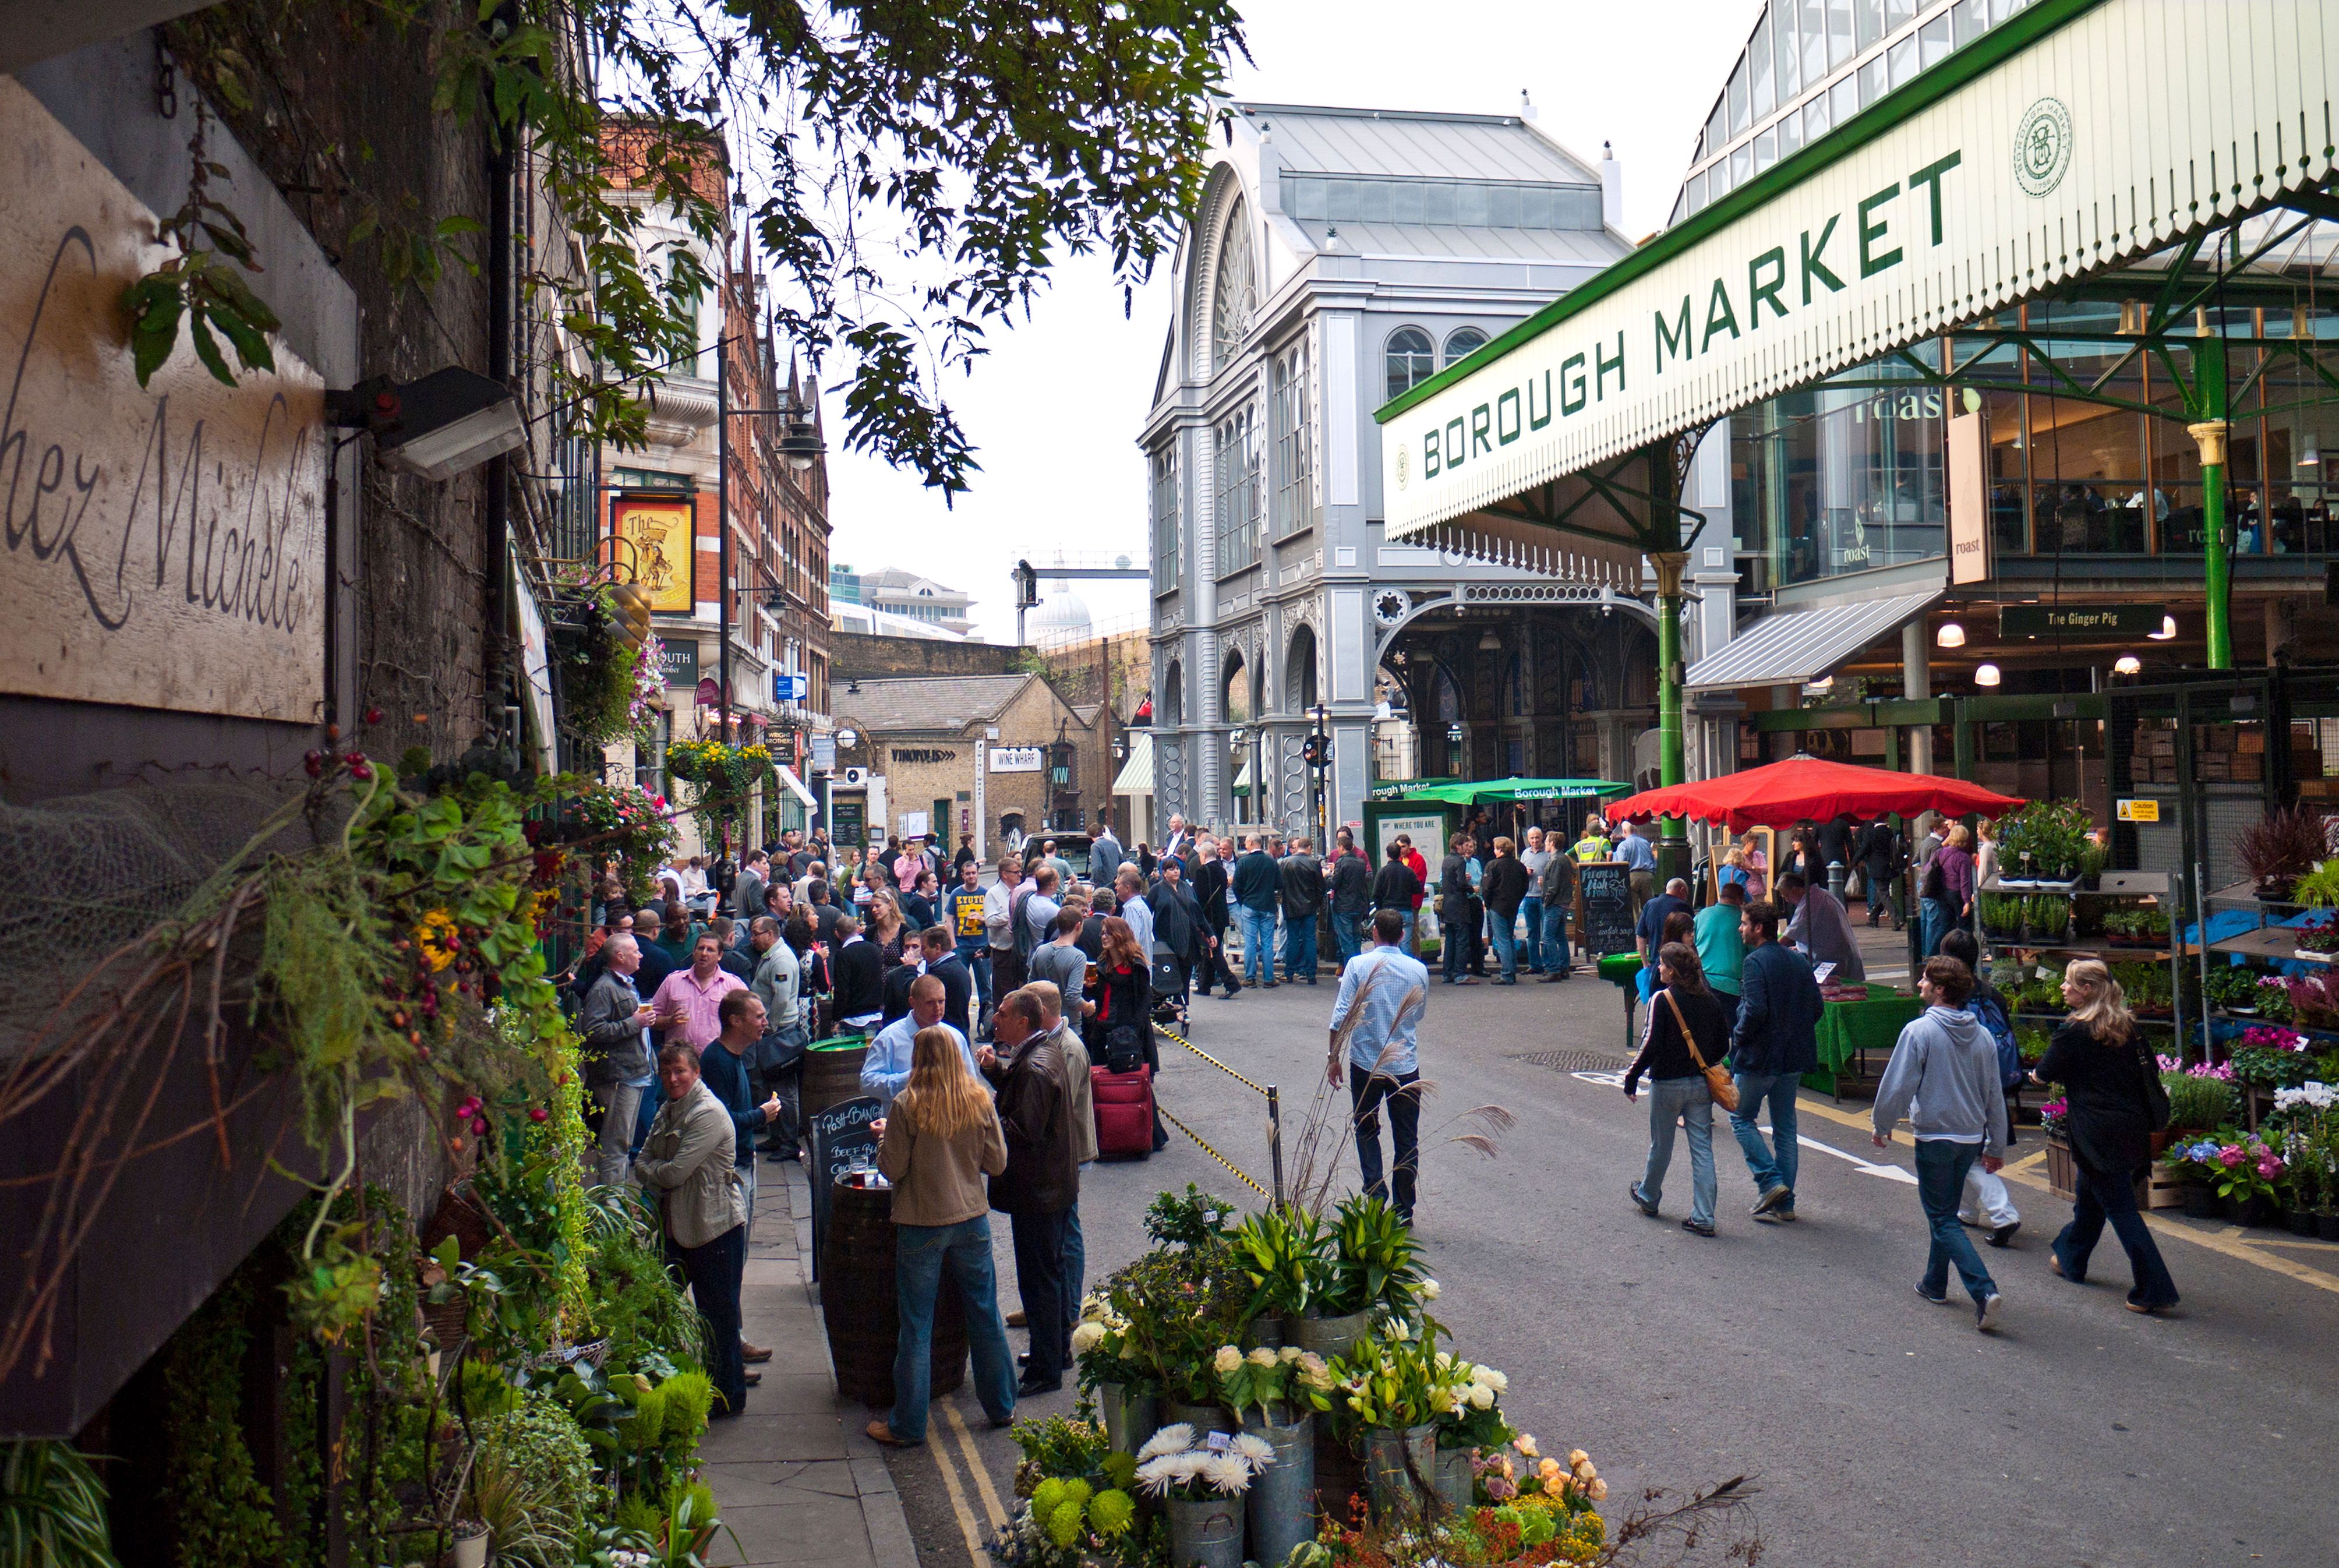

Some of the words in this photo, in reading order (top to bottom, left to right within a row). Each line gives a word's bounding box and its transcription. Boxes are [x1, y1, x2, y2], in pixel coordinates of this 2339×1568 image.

[2034, 178, 2051, 190] 1756
[1424, 329, 1626, 481] BOROUGH
[1654, 149, 1962, 375] MARKET
[1856, 391, 1958, 423] roas
[1956, 537, 1980, 555] roast
[1844, 543, 1871, 563] roast
[2068, 612, 2099, 626] Ginger
[2101, 612, 2118, 626] Pig
[891, 749, 942, 762] VINOPOLIS
[998, 754, 1013, 765] WINE
[1015, 753, 1034, 765] WHARF
[1400, 782, 1430, 793] Market
[1515, 788, 1560, 799] Borough
[1561, 786, 1598, 796] Market
[1394, 822, 1412, 830] WHERE
[1414, 821, 1423, 829] YOU
[1584, 878, 1607, 898] fish
[1592, 889, 1609, 898] FOOD
[831, 1146, 861, 1158] BEEF
